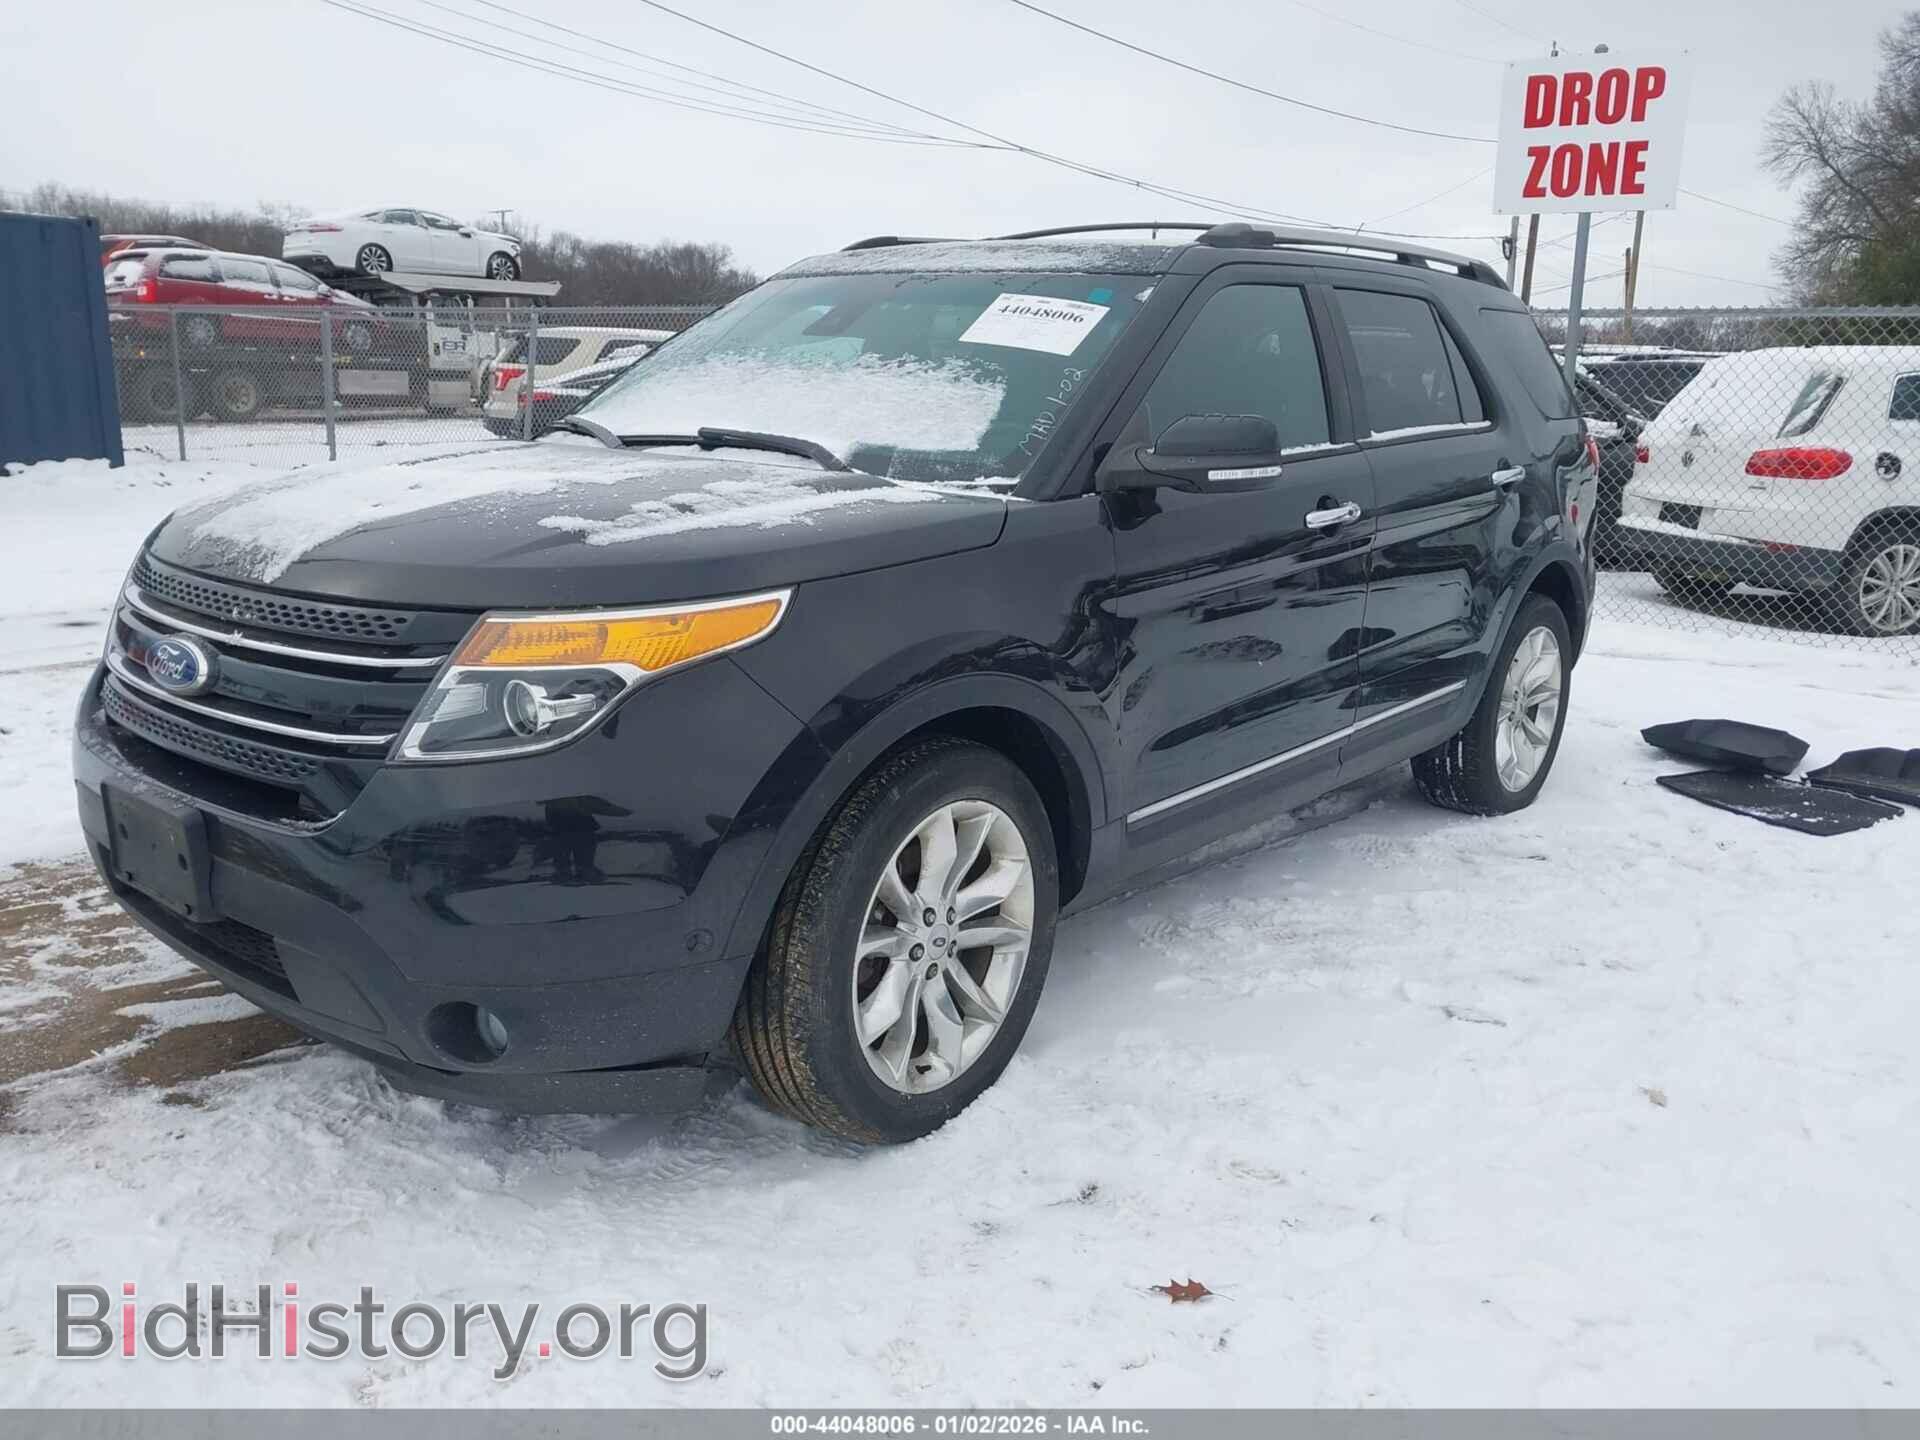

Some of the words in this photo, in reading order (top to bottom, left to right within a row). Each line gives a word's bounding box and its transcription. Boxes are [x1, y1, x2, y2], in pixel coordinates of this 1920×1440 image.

[1523, 65, 1667, 129] DROP
[1522, 140, 1650, 199] ZONE
[998, 303, 1085, 324] 44048006
[152, 644, 187, 680] Ford
